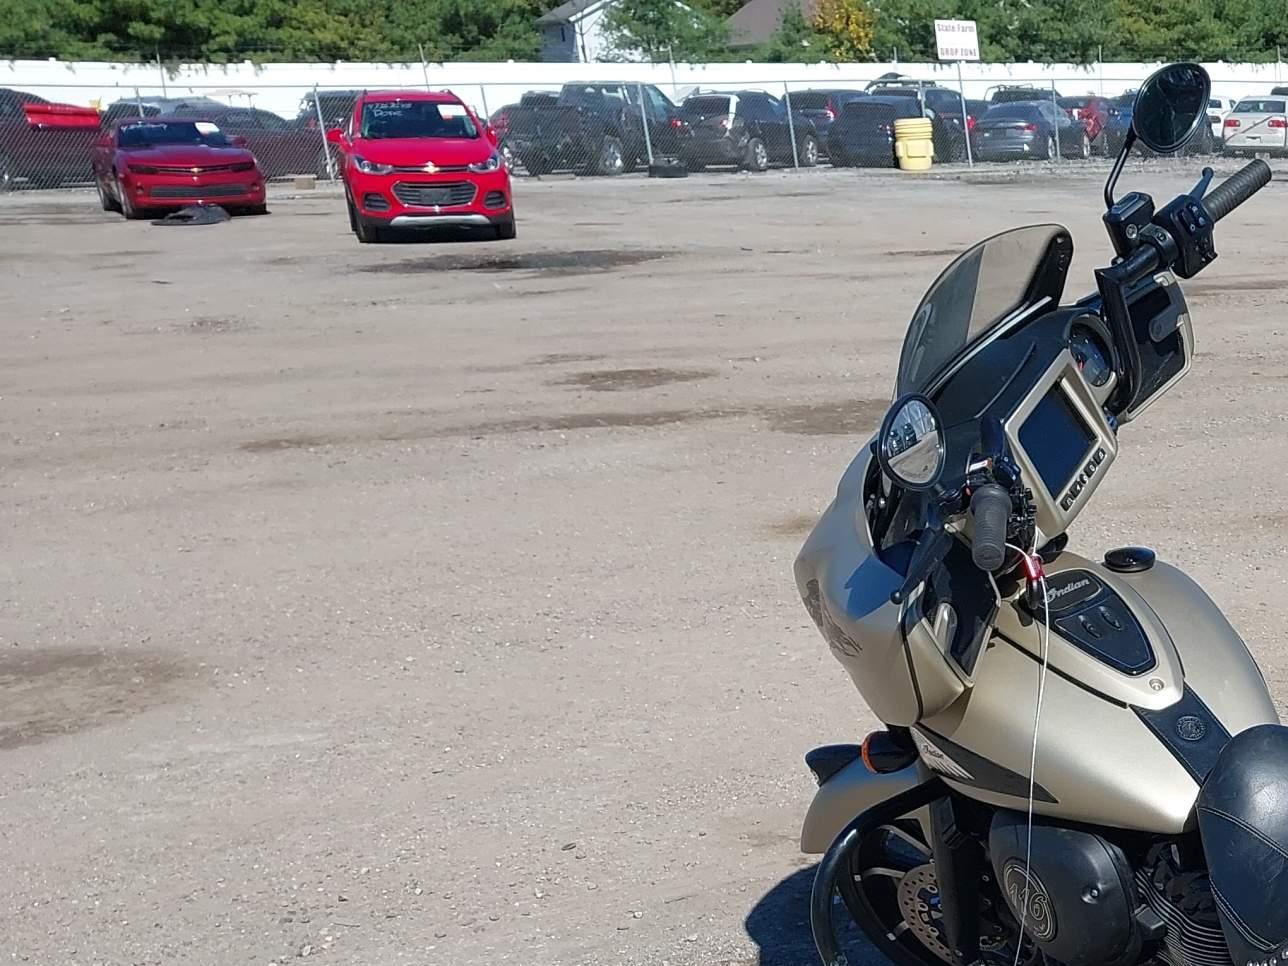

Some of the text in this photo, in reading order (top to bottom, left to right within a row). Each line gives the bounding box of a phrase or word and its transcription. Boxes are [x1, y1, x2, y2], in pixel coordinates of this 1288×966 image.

[937, 24, 975, 32] State Farm
[940, 47, 976, 57] DROP ZONE
[1043, 579, 1090, 603] Indian
